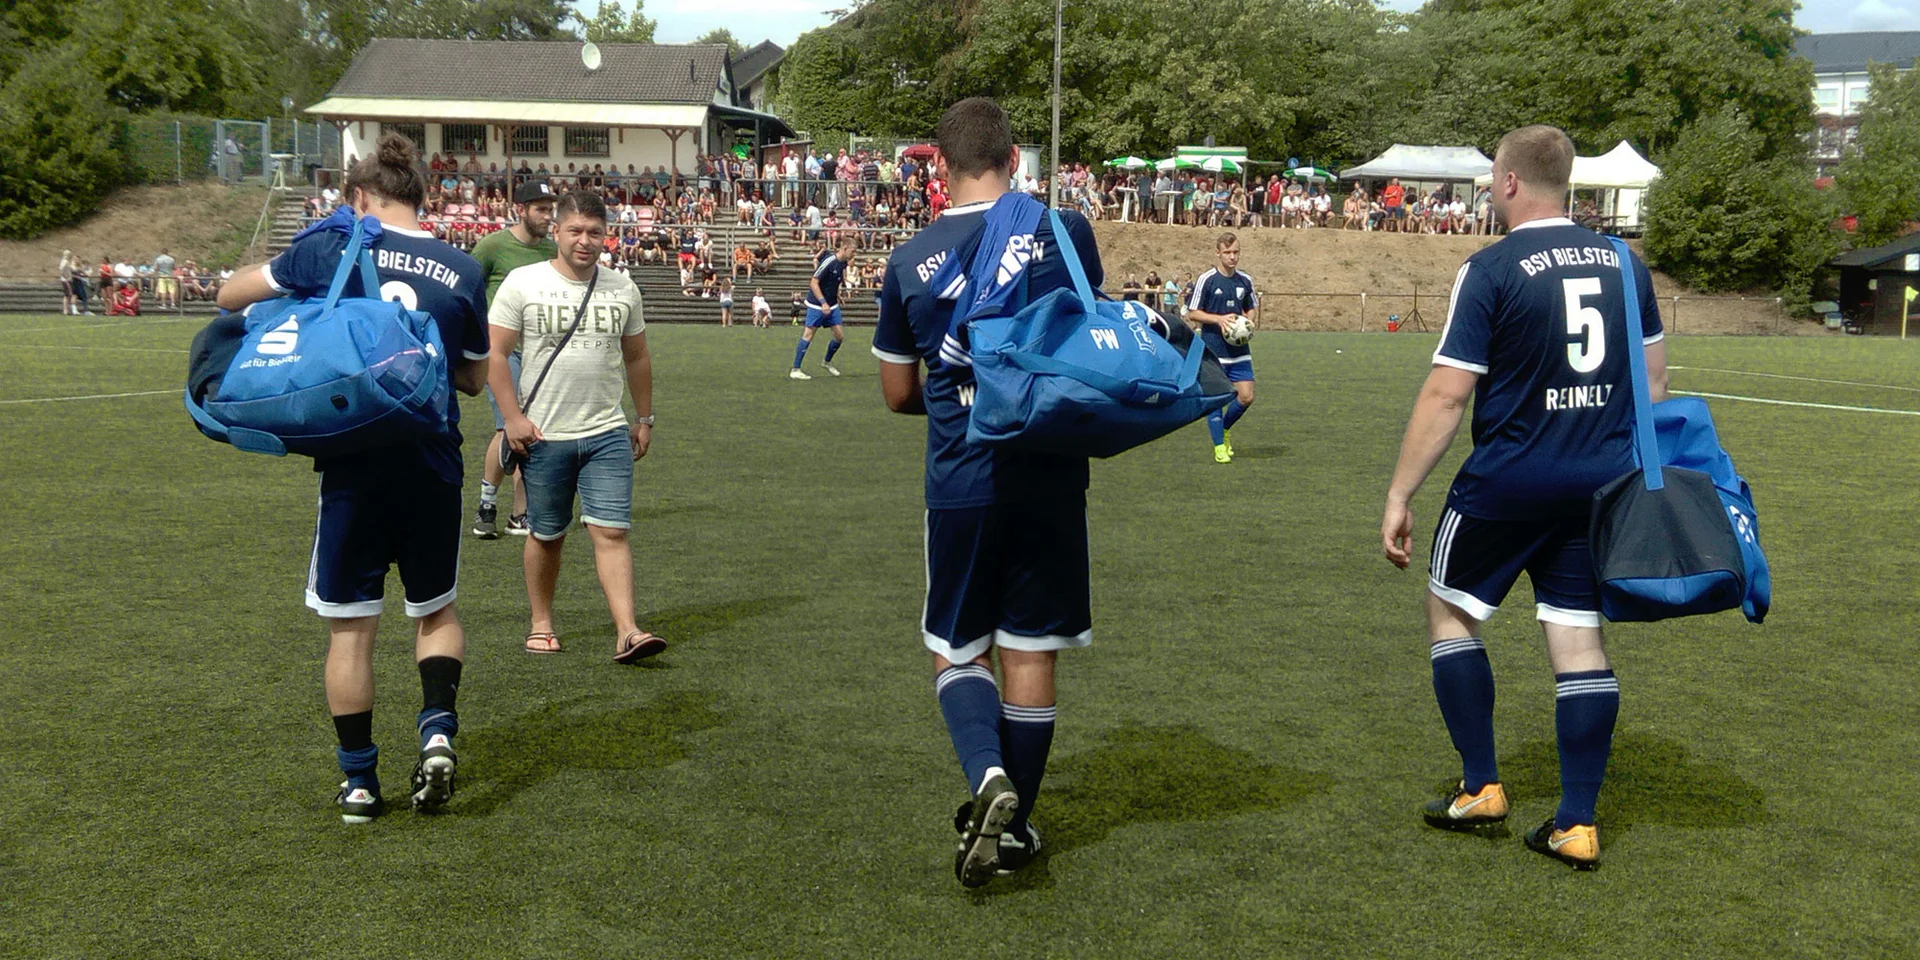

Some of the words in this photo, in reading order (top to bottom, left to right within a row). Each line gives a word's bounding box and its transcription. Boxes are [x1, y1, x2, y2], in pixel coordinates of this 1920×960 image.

[378, 249, 460, 289] BIELSTEIN
[916, 250, 947, 283] BSV
[1520, 250, 1552, 277] BSV
[539, 291, 568, 299] THE
[581, 291, 620, 300] CITY
[537, 304, 622, 334] NEVER
[1562, 277, 1606, 373] 5
[1090, 328, 1120, 350] PW
[253, 357, 267, 367] für
[1546, 384, 1613, 411] REINELT
